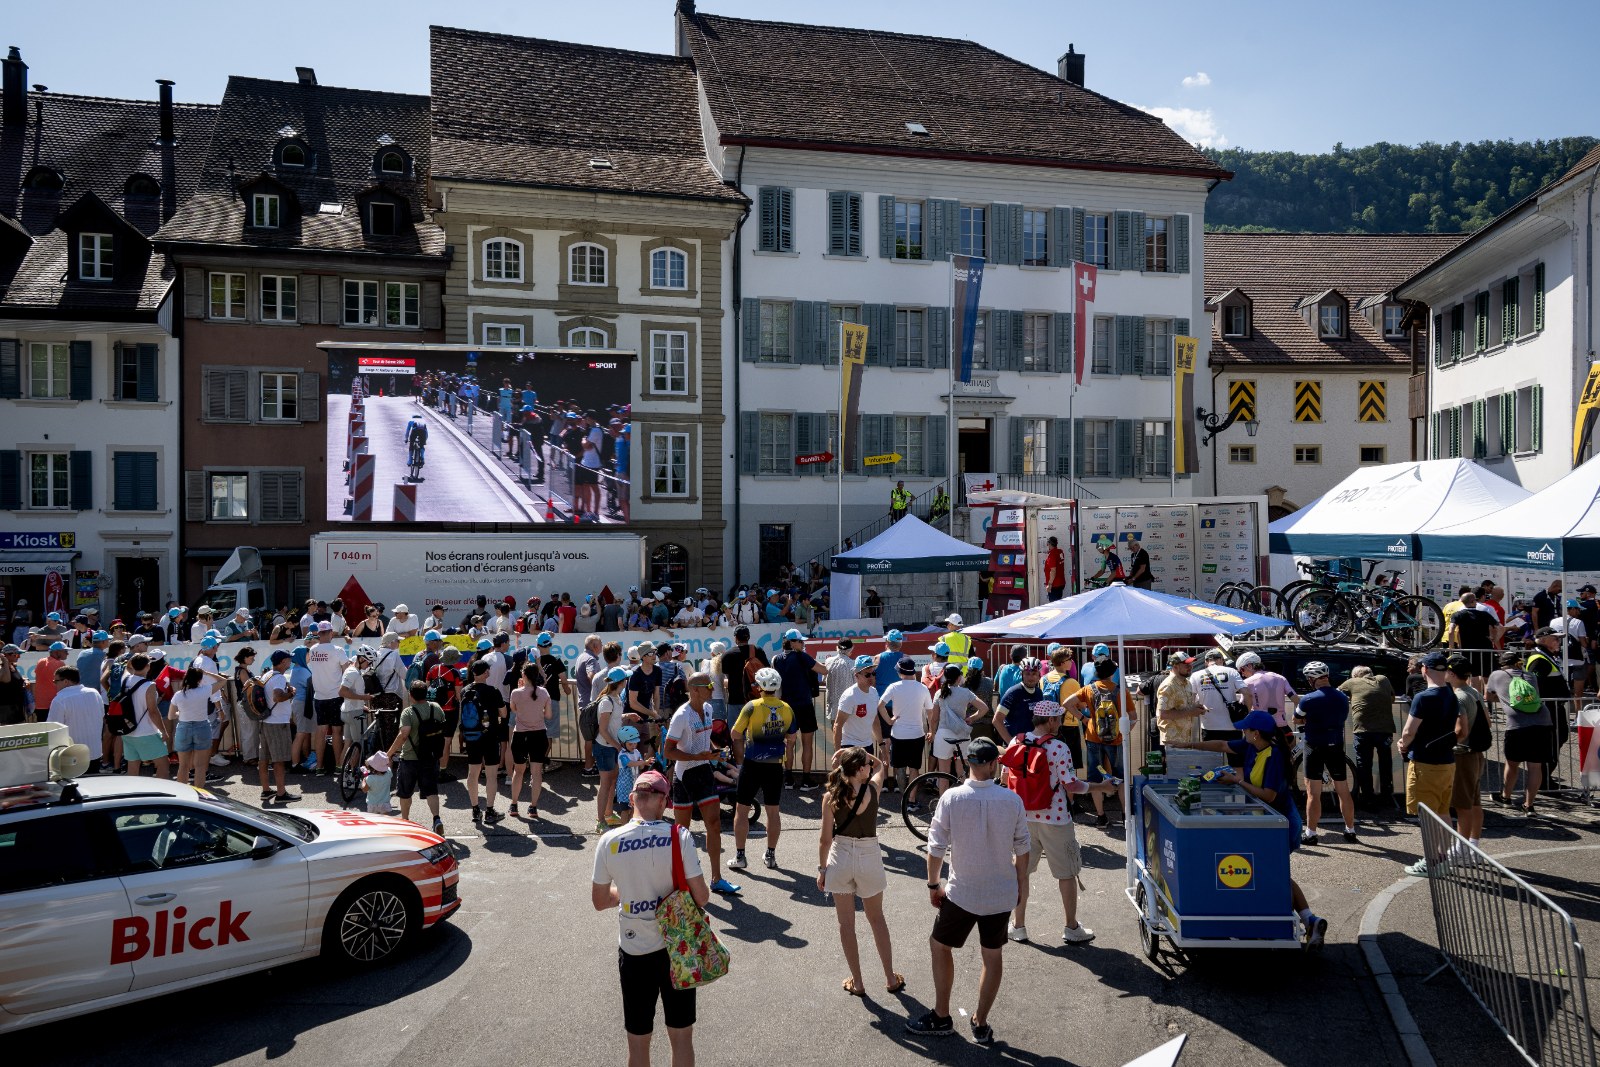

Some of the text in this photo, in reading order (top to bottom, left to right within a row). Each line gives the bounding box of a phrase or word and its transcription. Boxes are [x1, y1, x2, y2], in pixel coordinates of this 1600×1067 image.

[13, 534, 58, 547] Kiosk
[333, 551, 339, 560] 7
[341, 551, 360, 560] 040
[425, 550, 590, 562] Nos écrans roulent jusqu'à vous.
[1527, 551, 1555, 561] PROTENT
[425, 562, 555, 574] Location d'écrans géants
[110, 899, 252, 965] Blick
